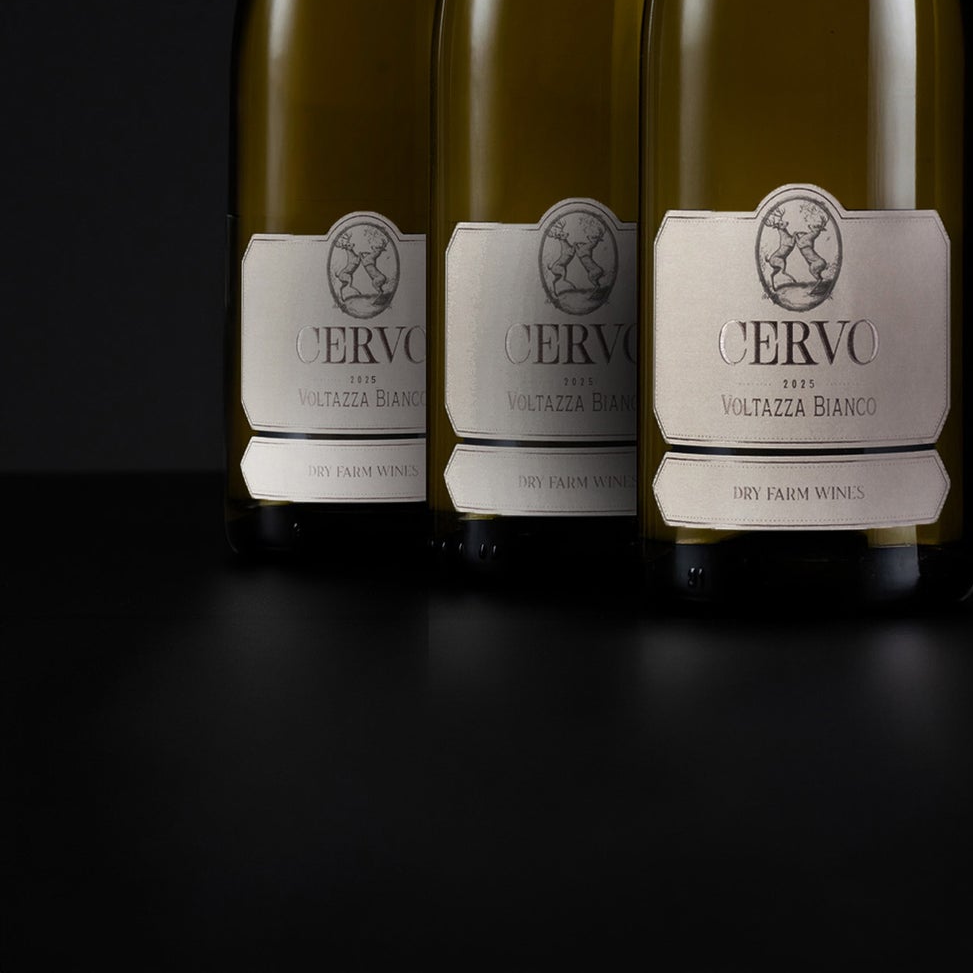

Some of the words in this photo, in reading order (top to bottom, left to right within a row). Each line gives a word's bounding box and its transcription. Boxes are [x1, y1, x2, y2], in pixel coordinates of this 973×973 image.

[295, 325, 426, 365] CERVO
[718, 319, 880, 366] CERVO
[350, 375, 377, 384] 2025
[564, 377, 594, 387] 2025
[783, 379, 815, 389] 2025
[592, 392, 637, 413] BIANC
[721, 394, 806, 417] VOLTAZZA
[813, 395, 877, 417] BIANCO
[308, 465, 333, 478] DRY
[337, 465, 372, 478] FARM
[377, 465, 419, 477] WINES
[518, 475, 544, 489] DRY
[549, 475, 588, 489] FARM
[733, 486, 762, 500] DRY
[767, 486, 809, 501] FARM
[815, 485, 866, 500] WINES
